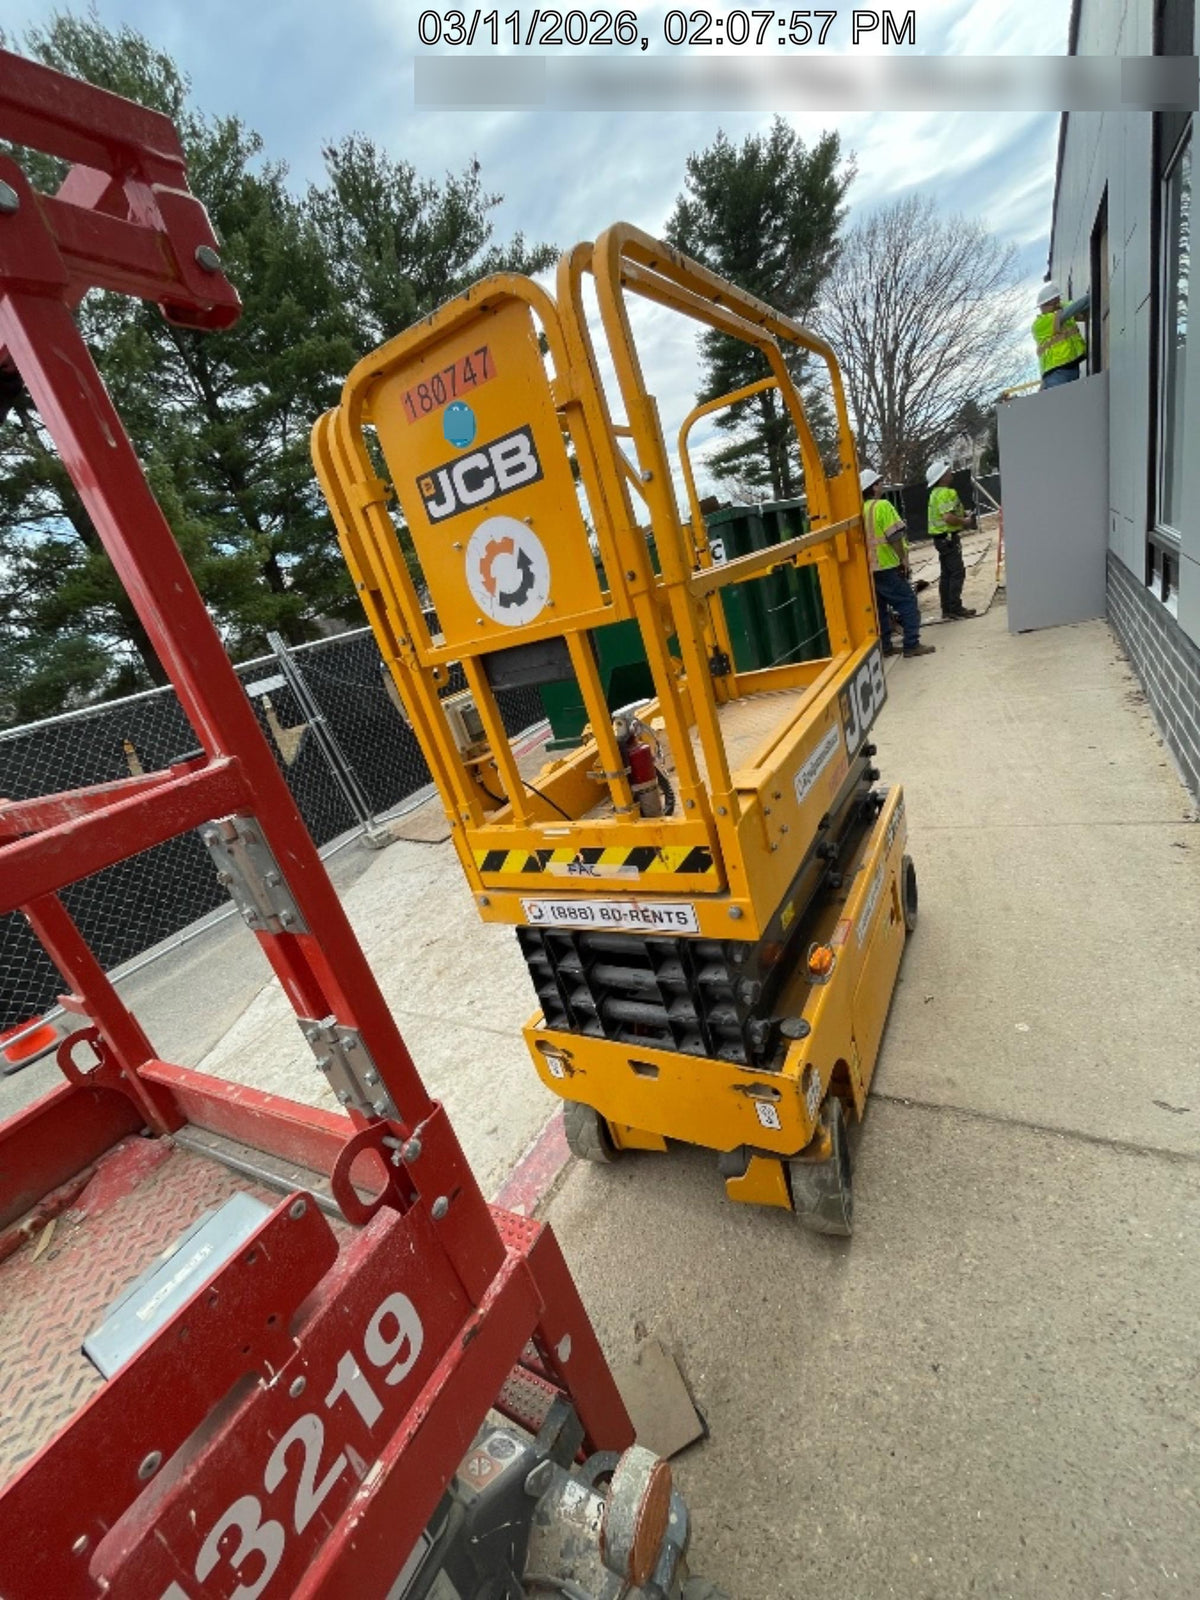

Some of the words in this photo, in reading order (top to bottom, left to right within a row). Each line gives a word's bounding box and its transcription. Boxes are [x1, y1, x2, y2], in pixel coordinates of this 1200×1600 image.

[404, 346, 489, 418] 180747
[427, 433, 538, 518] JCB
[845, 648, 885, 755] JCB
[550, 905, 595, 922] (888)
